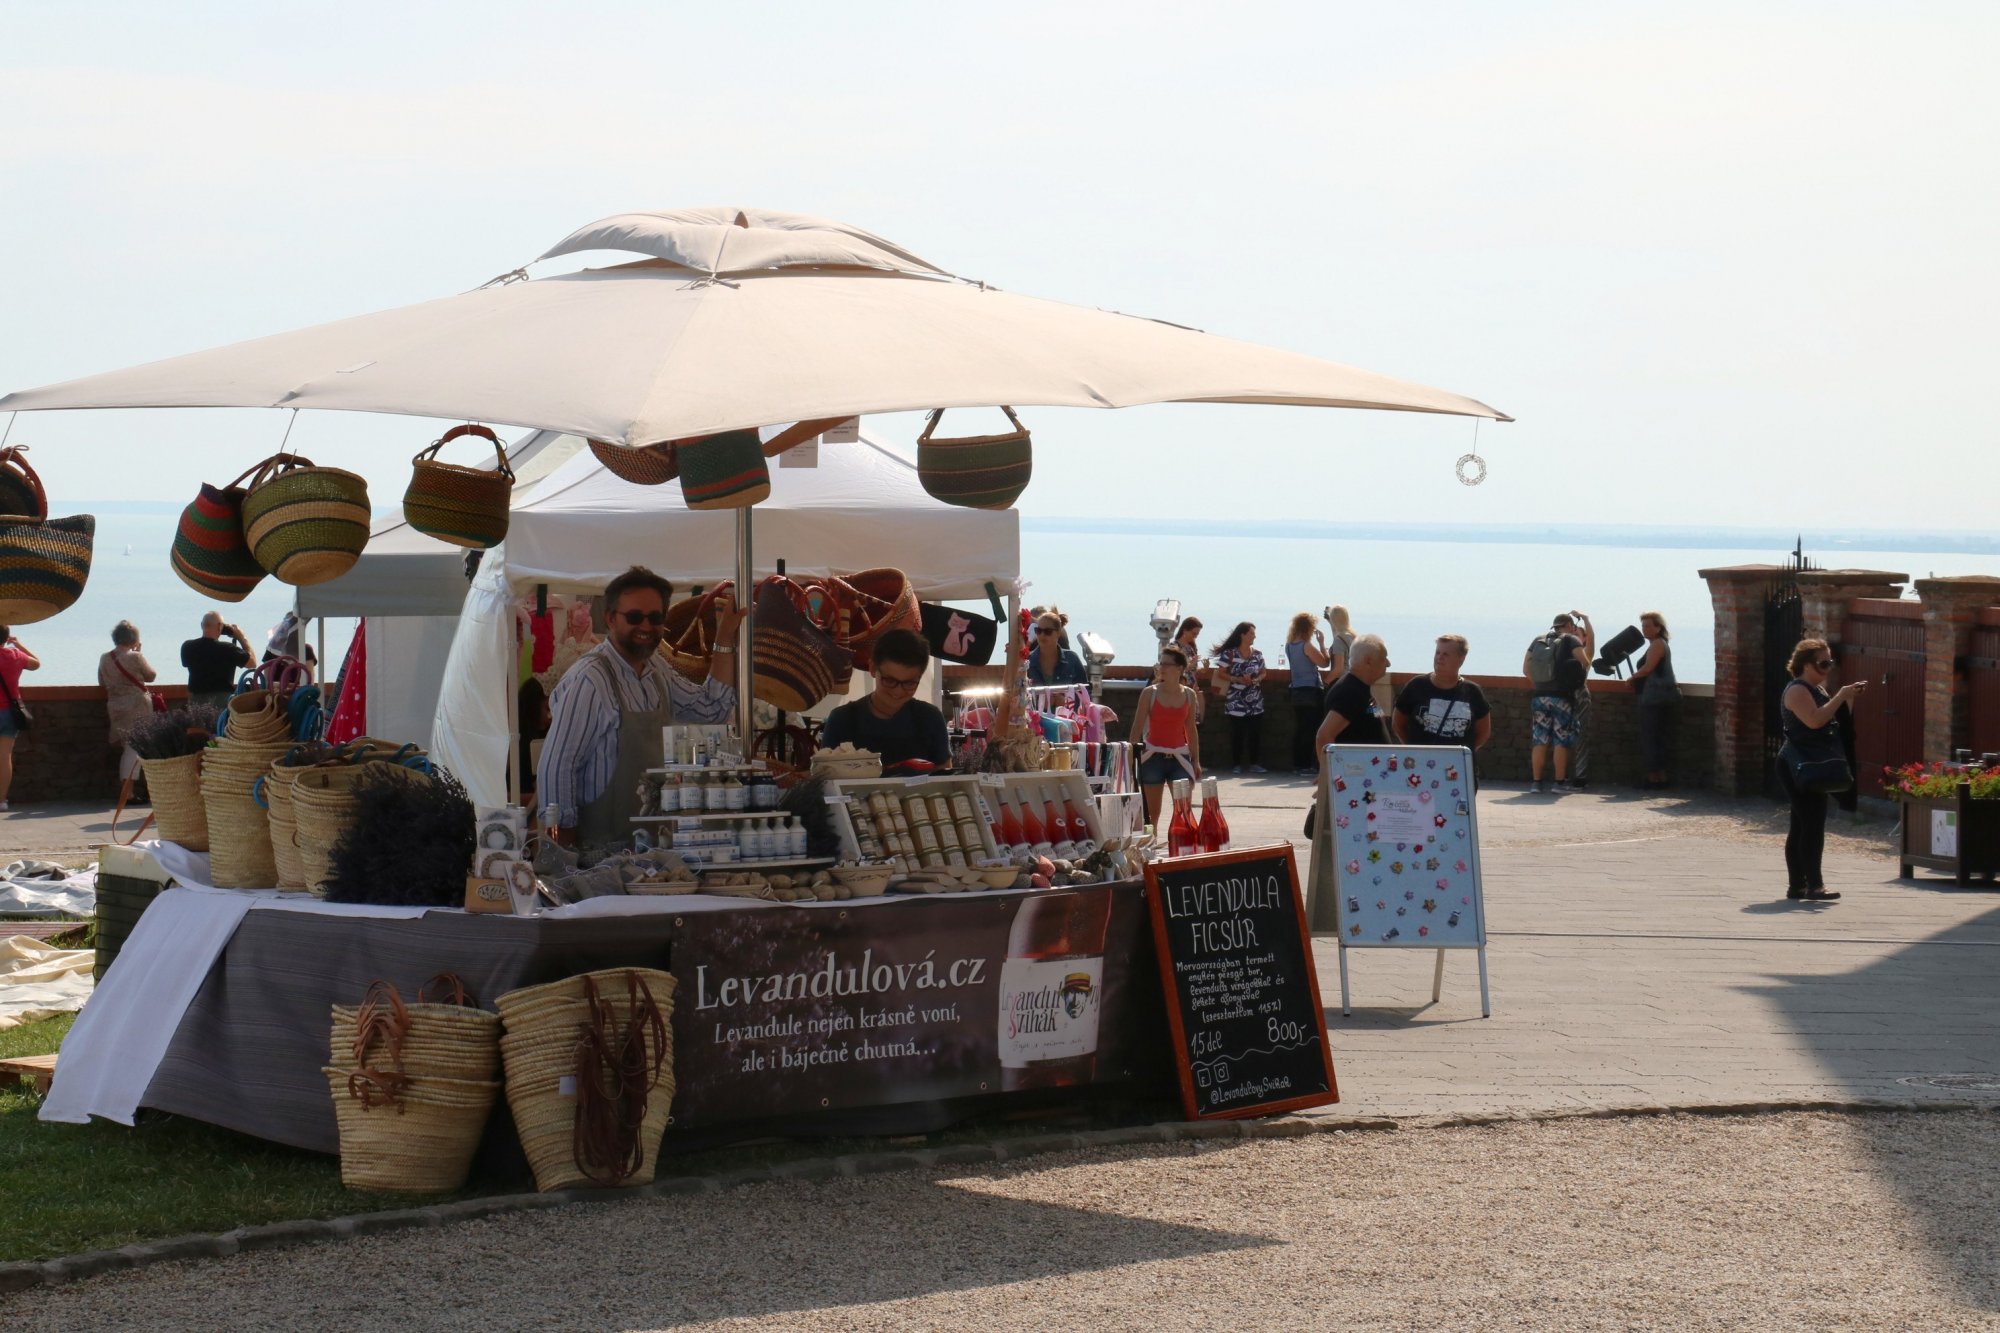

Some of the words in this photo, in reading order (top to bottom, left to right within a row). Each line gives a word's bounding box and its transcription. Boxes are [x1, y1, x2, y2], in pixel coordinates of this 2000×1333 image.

[1166, 876, 1280, 918] LEVENDULA
[1191, 912, 1260, 954] FICSÚR
[1246, 953, 1275, 965] termett
[1247, 967, 1263, 977] bor,
[695, 948, 986, 1010] Levandulová.cz
[1190, 981, 1228, 996] levendula
[1275, 974, 1285, 985] és
[1191, 996, 1216, 1011] fekete
[714, 1014, 803, 1044] Levandule
[808, 1012, 855, 1039] nejen
[860, 1004, 917, 1029] krásně
[920, 1002, 961, 1023] voní,
[741, 1049, 765, 1073] ale
[770, 1049, 777, 1069] i
[781, 1041, 849, 1073] báječně
[854, 1036, 937, 1061] chutná...
